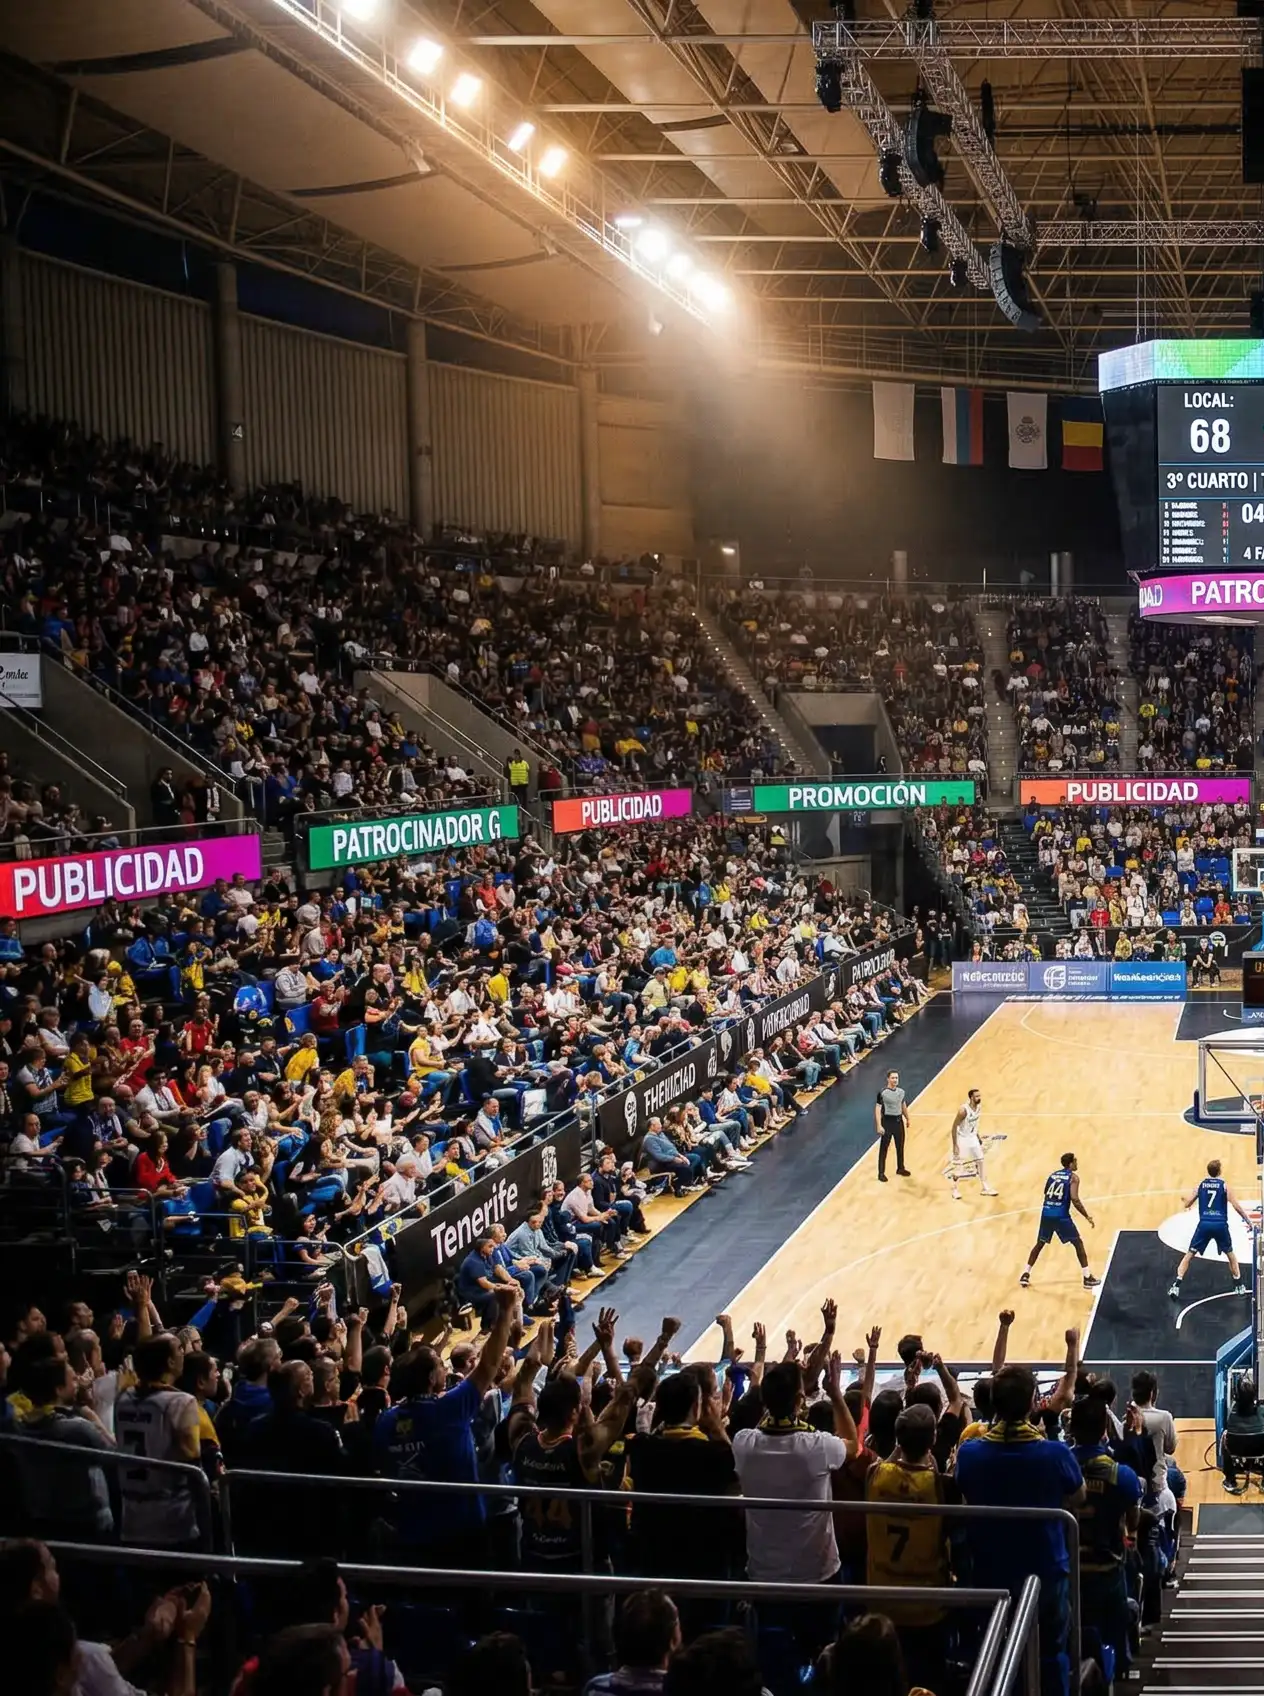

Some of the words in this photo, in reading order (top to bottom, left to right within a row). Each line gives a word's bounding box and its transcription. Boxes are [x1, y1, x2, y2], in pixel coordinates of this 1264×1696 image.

[1184, 392, 1234, 408] LOCAL:
[1190, 418, 1231, 453] 68
[1167, 472, 1183, 489] 3º
[1187, 472, 1248, 489] CUARTO
[1243, 547, 1251, 560] 4
[788, 780, 927, 808] PROMOCIÓN
[1066, 782, 1199, 802] PUBLICIDAD
[580, 794, 663, 826] PUBLICIDAD
[333, 813, 484, 862] PATROCINADOR
[14, 847, 204, 911] PUBLICIDAD
[1046, 1182, 1065, 1200] 44
[1207, 1189, 1217, 1208] 7
[430, 1177, 519, 1265] Tenerife
[886, 1523, 910, 1563] 7
